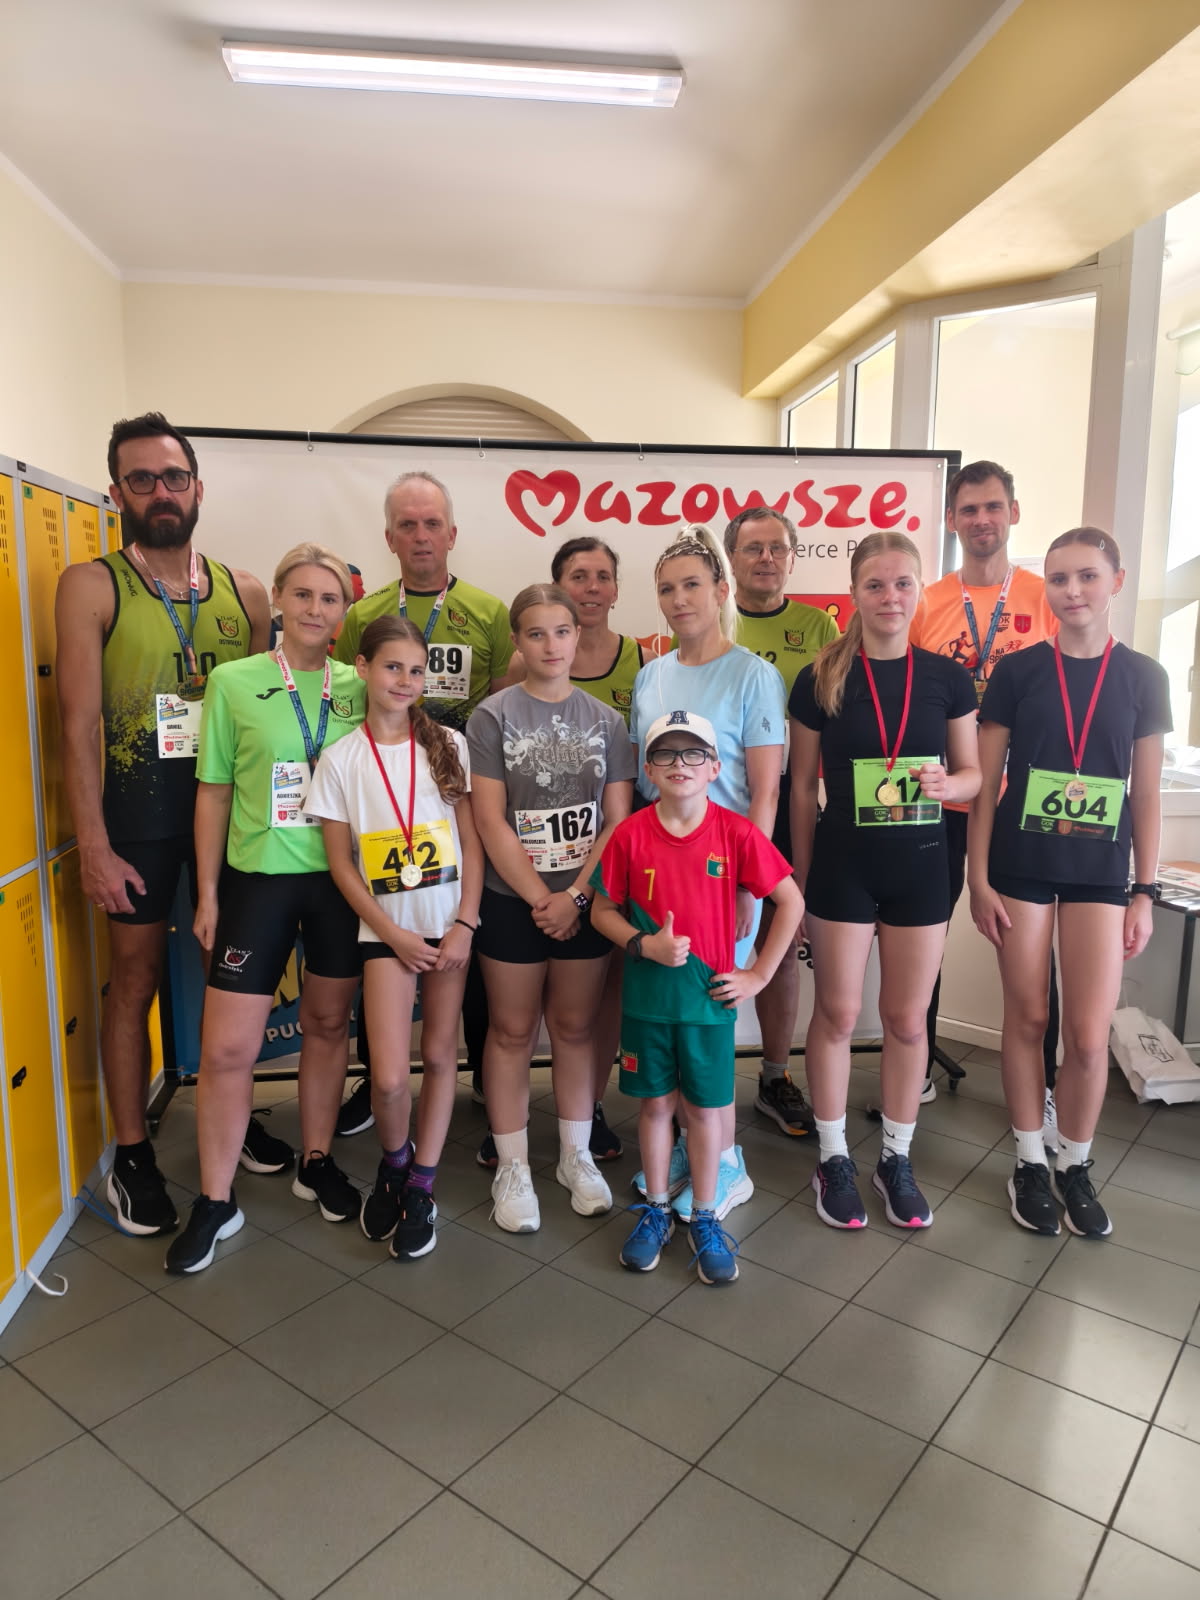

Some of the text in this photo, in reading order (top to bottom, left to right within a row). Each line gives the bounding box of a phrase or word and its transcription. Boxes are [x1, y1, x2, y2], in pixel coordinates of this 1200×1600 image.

[794, 541, 838, 559] erce
[1041, 790, 1107, 821] 604
[545, 806, 593, 844] 162
